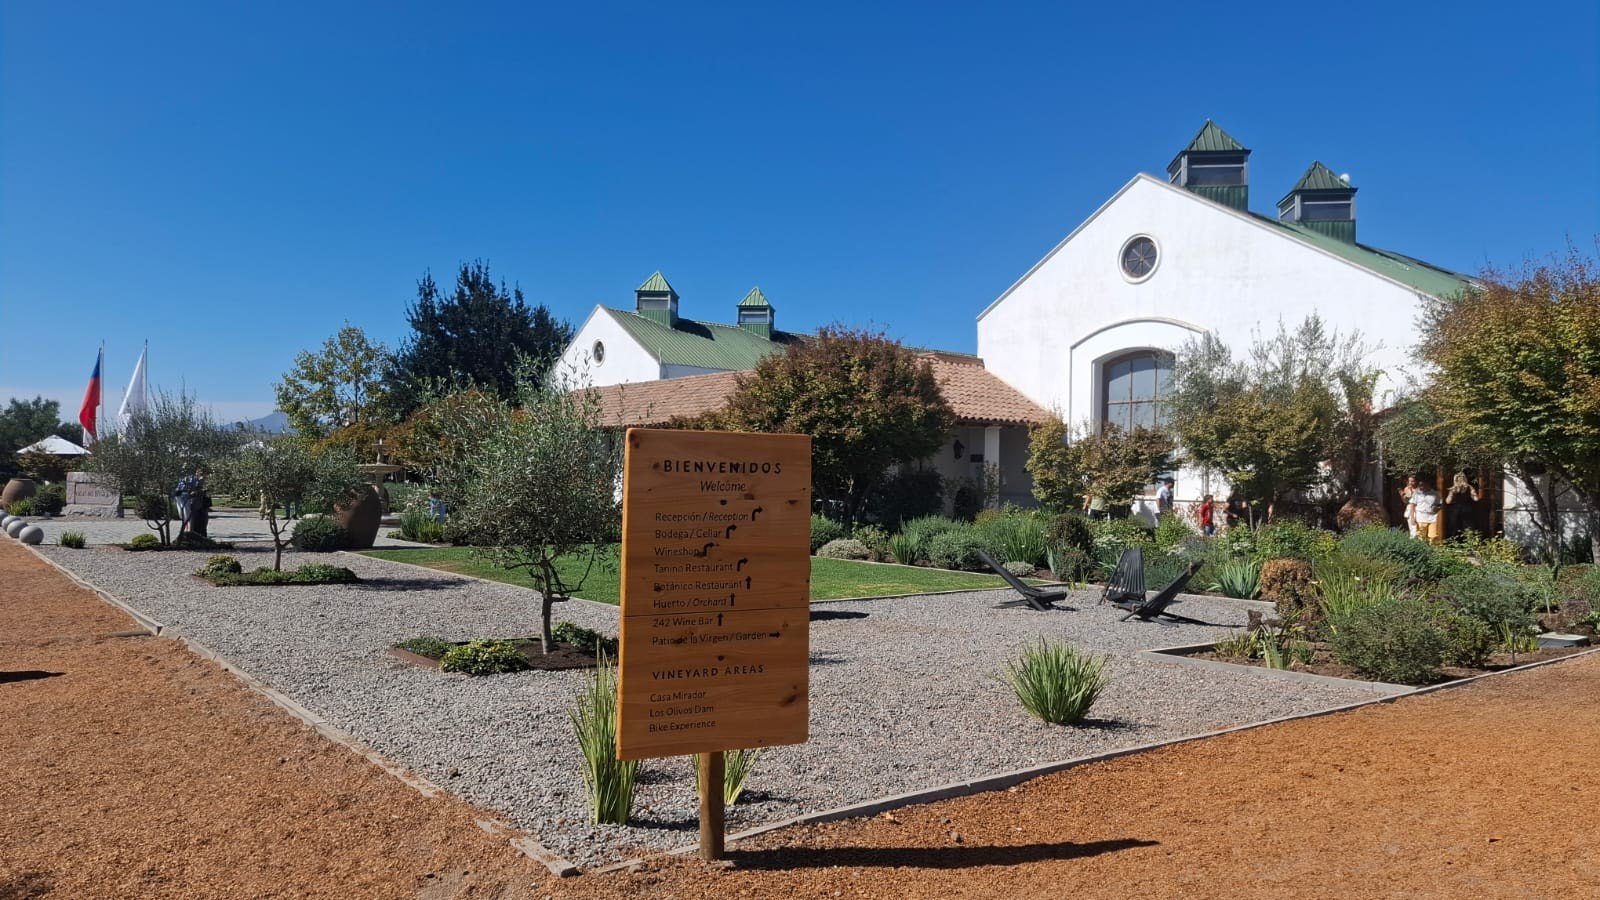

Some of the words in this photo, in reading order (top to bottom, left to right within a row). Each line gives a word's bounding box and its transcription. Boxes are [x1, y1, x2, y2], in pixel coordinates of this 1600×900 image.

[664, 460, 781, 474] BIENVENIDOS
[700, 480, 746, 492] Welcome
[708, 511, 749, 522] Reception
[655, 529, 689, 540] Bodega
[696, 528, 722, 538] Cellar
[654, 546, 700, 557] Wineshop
[654, 563, 683, 573] Tanino
[685, 563, 733, 572] Restaurant
[695, 581, 742, 590] Restaurant
[692, 597, 727, 607] Orchard
[652, 618, 670, 628] 242
[672, 617, 697, 626] Wine
[698, 616, 713, 625] Bar
[700, 633, 729, 644] Virgen
[735, 631, 767, 641] Garden
[652, 667, 719, 680] VINEYARD
[724, 664, 764, 675] AREAS
[650, 693, 671, 703] Casa
[672, 690, 706, 700] Mirador
[649, 708, 664, 718] Los
[666, 705, 693, 716] Olivos
[694, 704, 714, 714] Dam
[649, 722, 668, 733] Bike
[669, 719, 716, 731] Experience
